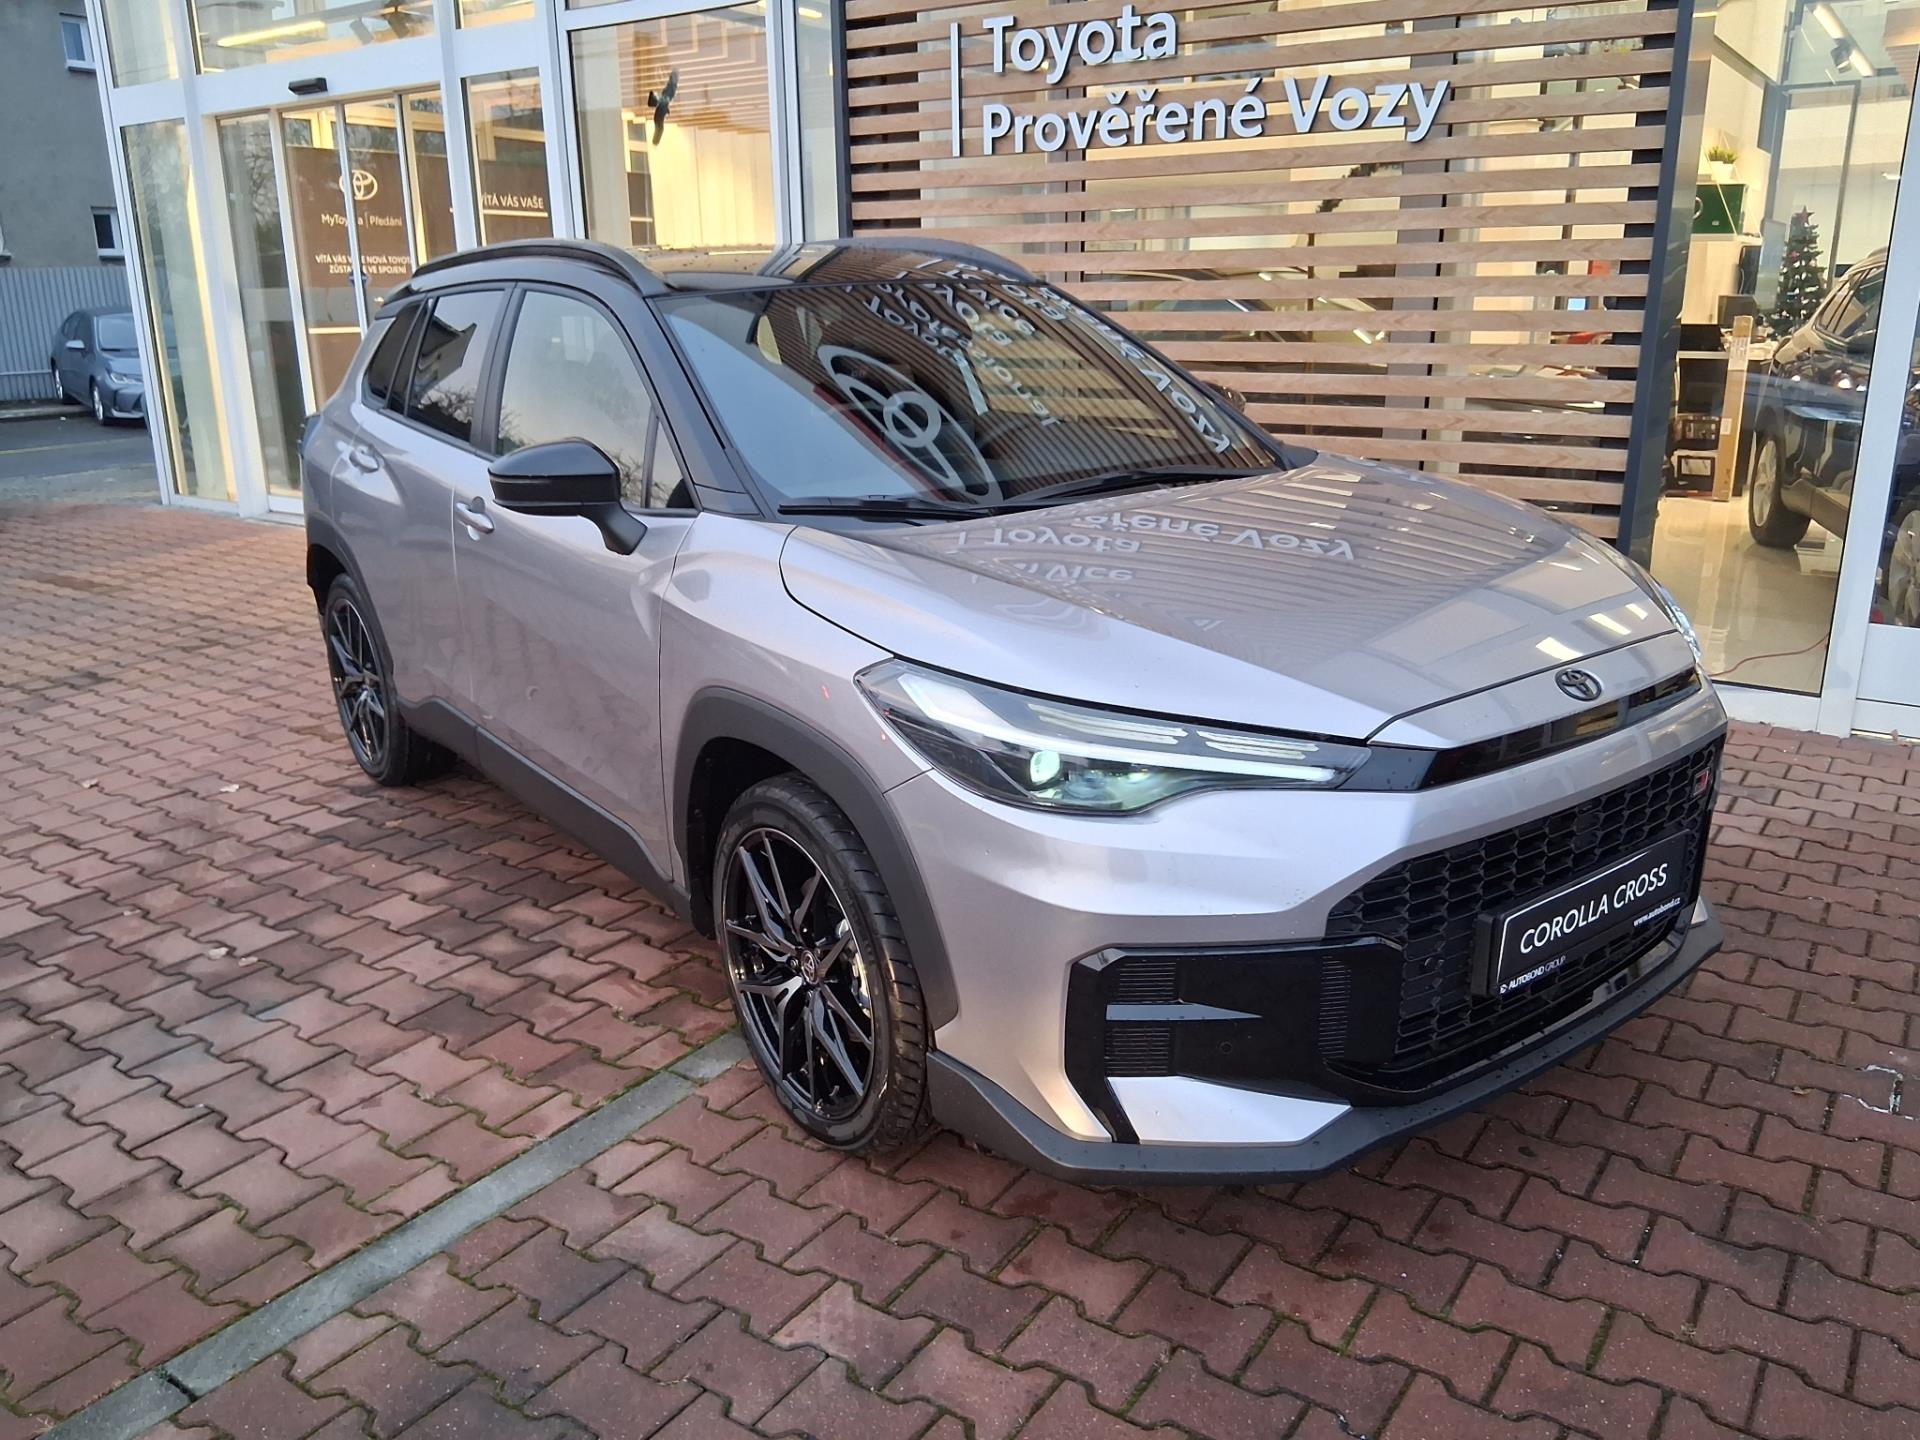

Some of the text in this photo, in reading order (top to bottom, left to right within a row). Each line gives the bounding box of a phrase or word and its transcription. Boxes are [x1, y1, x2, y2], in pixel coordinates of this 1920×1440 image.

[983, 4, 1178, 84] Toyota
[983, 74, 1449, 155] Prověřené Vozy
[321, 213, 363, 227] MyToya
[481, 193, 544, 209] ÍTÁ VÁS VAŠE
[1519, 862, 1668, 954] COROLLA CROSS
